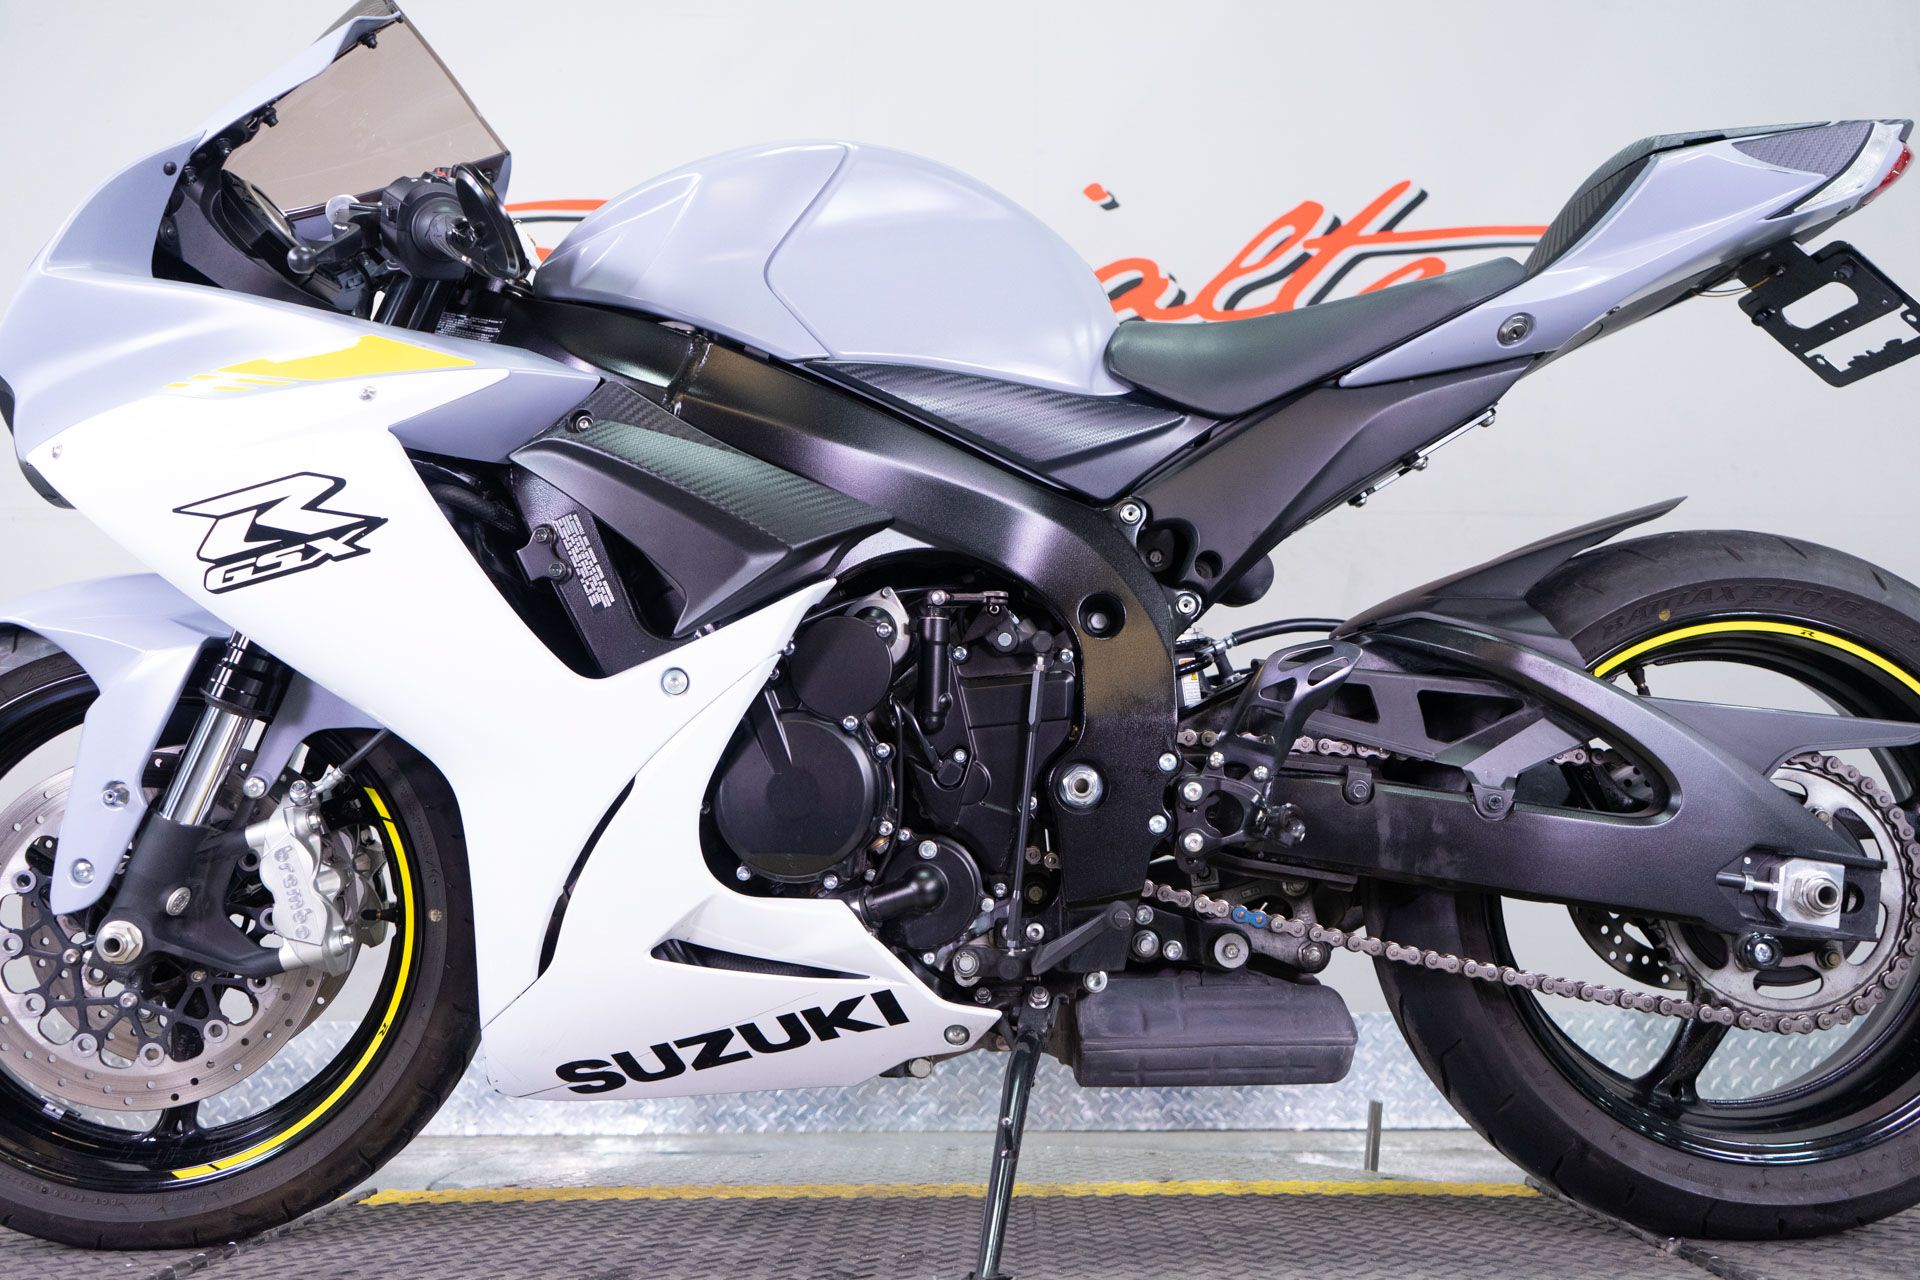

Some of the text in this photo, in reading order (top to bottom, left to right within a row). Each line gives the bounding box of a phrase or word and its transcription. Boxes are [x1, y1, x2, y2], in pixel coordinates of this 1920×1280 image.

[203, 525, 387, 594] GSX
[274, 845, 313, 939] brembo
[555, 989, 910, 1094] SUZUKI
